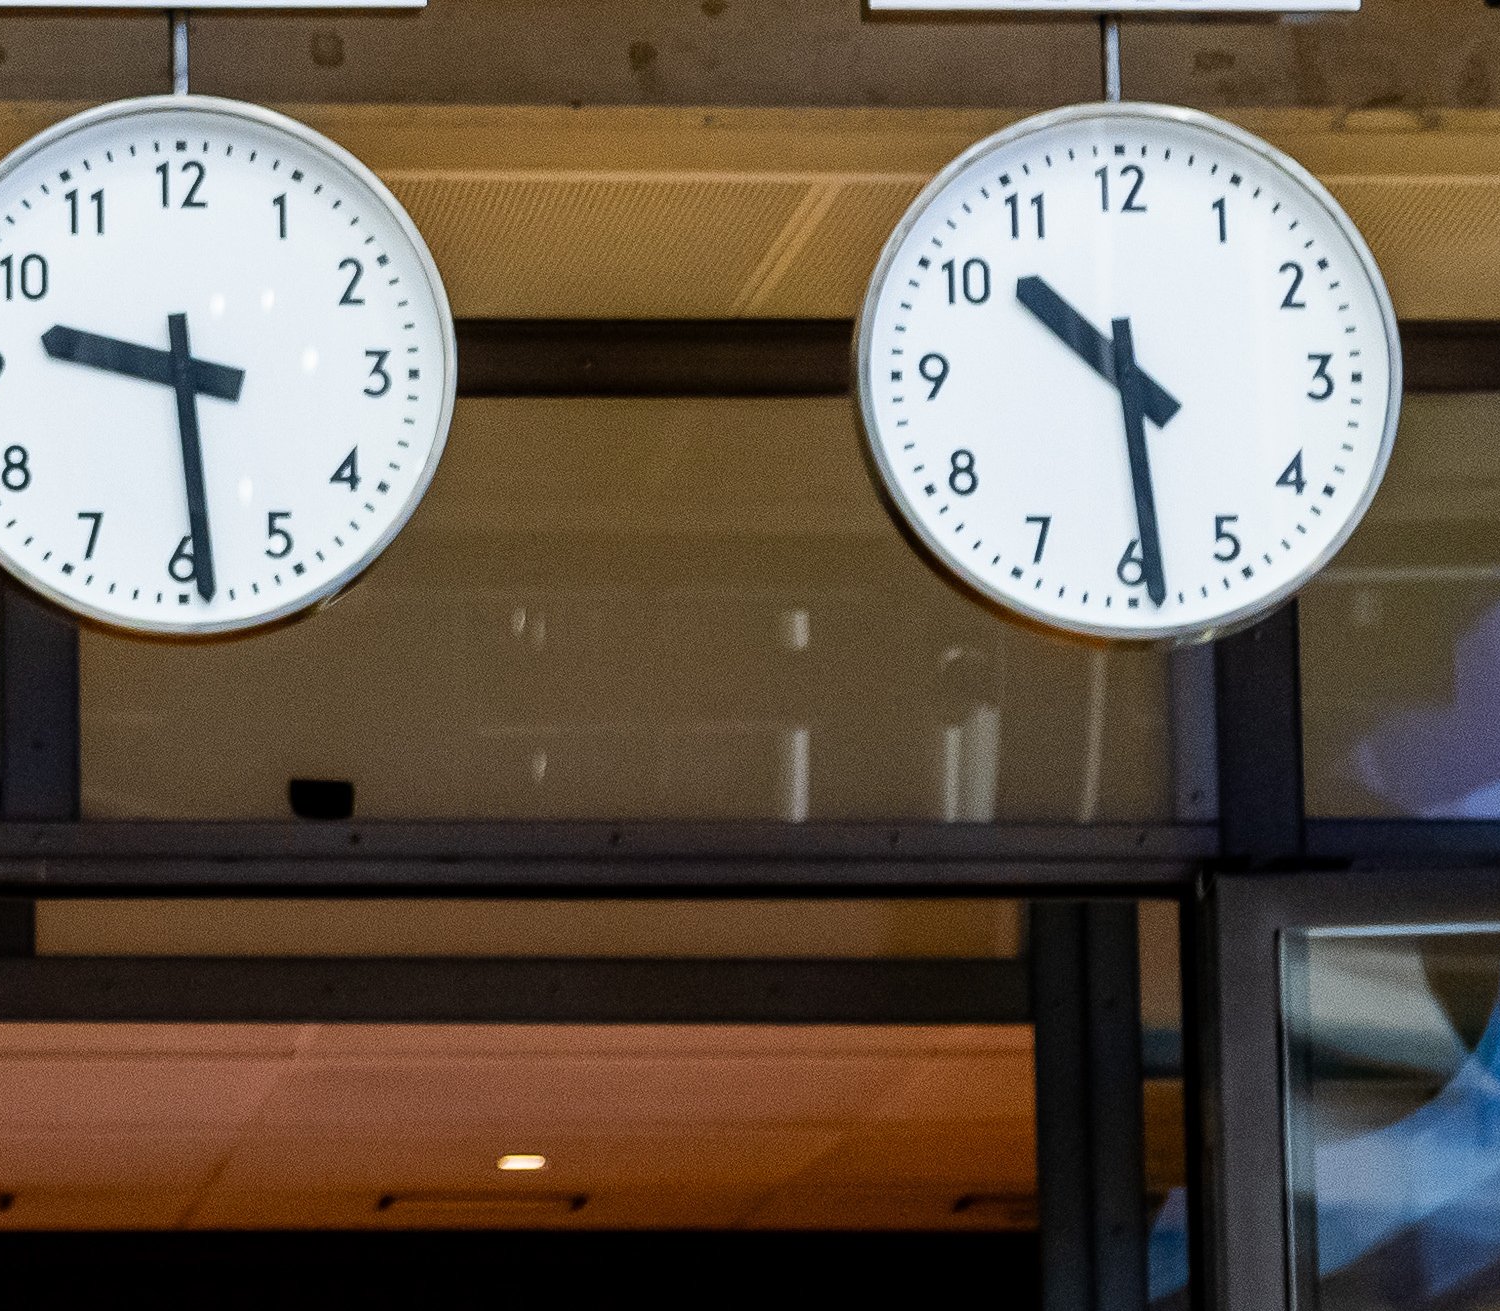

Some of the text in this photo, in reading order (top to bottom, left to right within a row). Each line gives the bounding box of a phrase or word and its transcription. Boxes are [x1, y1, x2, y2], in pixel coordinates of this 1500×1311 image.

[155, 160, 207, 208] 12
[1095, 164, 1146, 212] 12
[64, 189, 104, 235] 11
[272, 193, 286, 239] 1
[1004, 193, 1044, 239] 11
[1212, 197, 1226, 243] 1
[0, 253, 48, 301] 10
[338, 257, 364, 305] 2
[941, 258, 991, 305] 10
[1279, 261, 1306, 309] 2
[363, 350, 391, 397] 3
[918, 353, 949, 400] 9
[1307, 353, 1334, 401] 3
[1, 444, 31, 492] 8
[329, 447, 360, 491] 4
[948, 449, 978, 496] 8
[1275, 451, 1306, 494] 4
[77, 511, 103, 560] 7
[265, 511, 293, 559] 5
[1025, 516, 1051, 564] 7
[1214, 515, 1241, 562] 5
[169, 536, 201, 582] 6
[1117, 539, 1149, 586] 6
